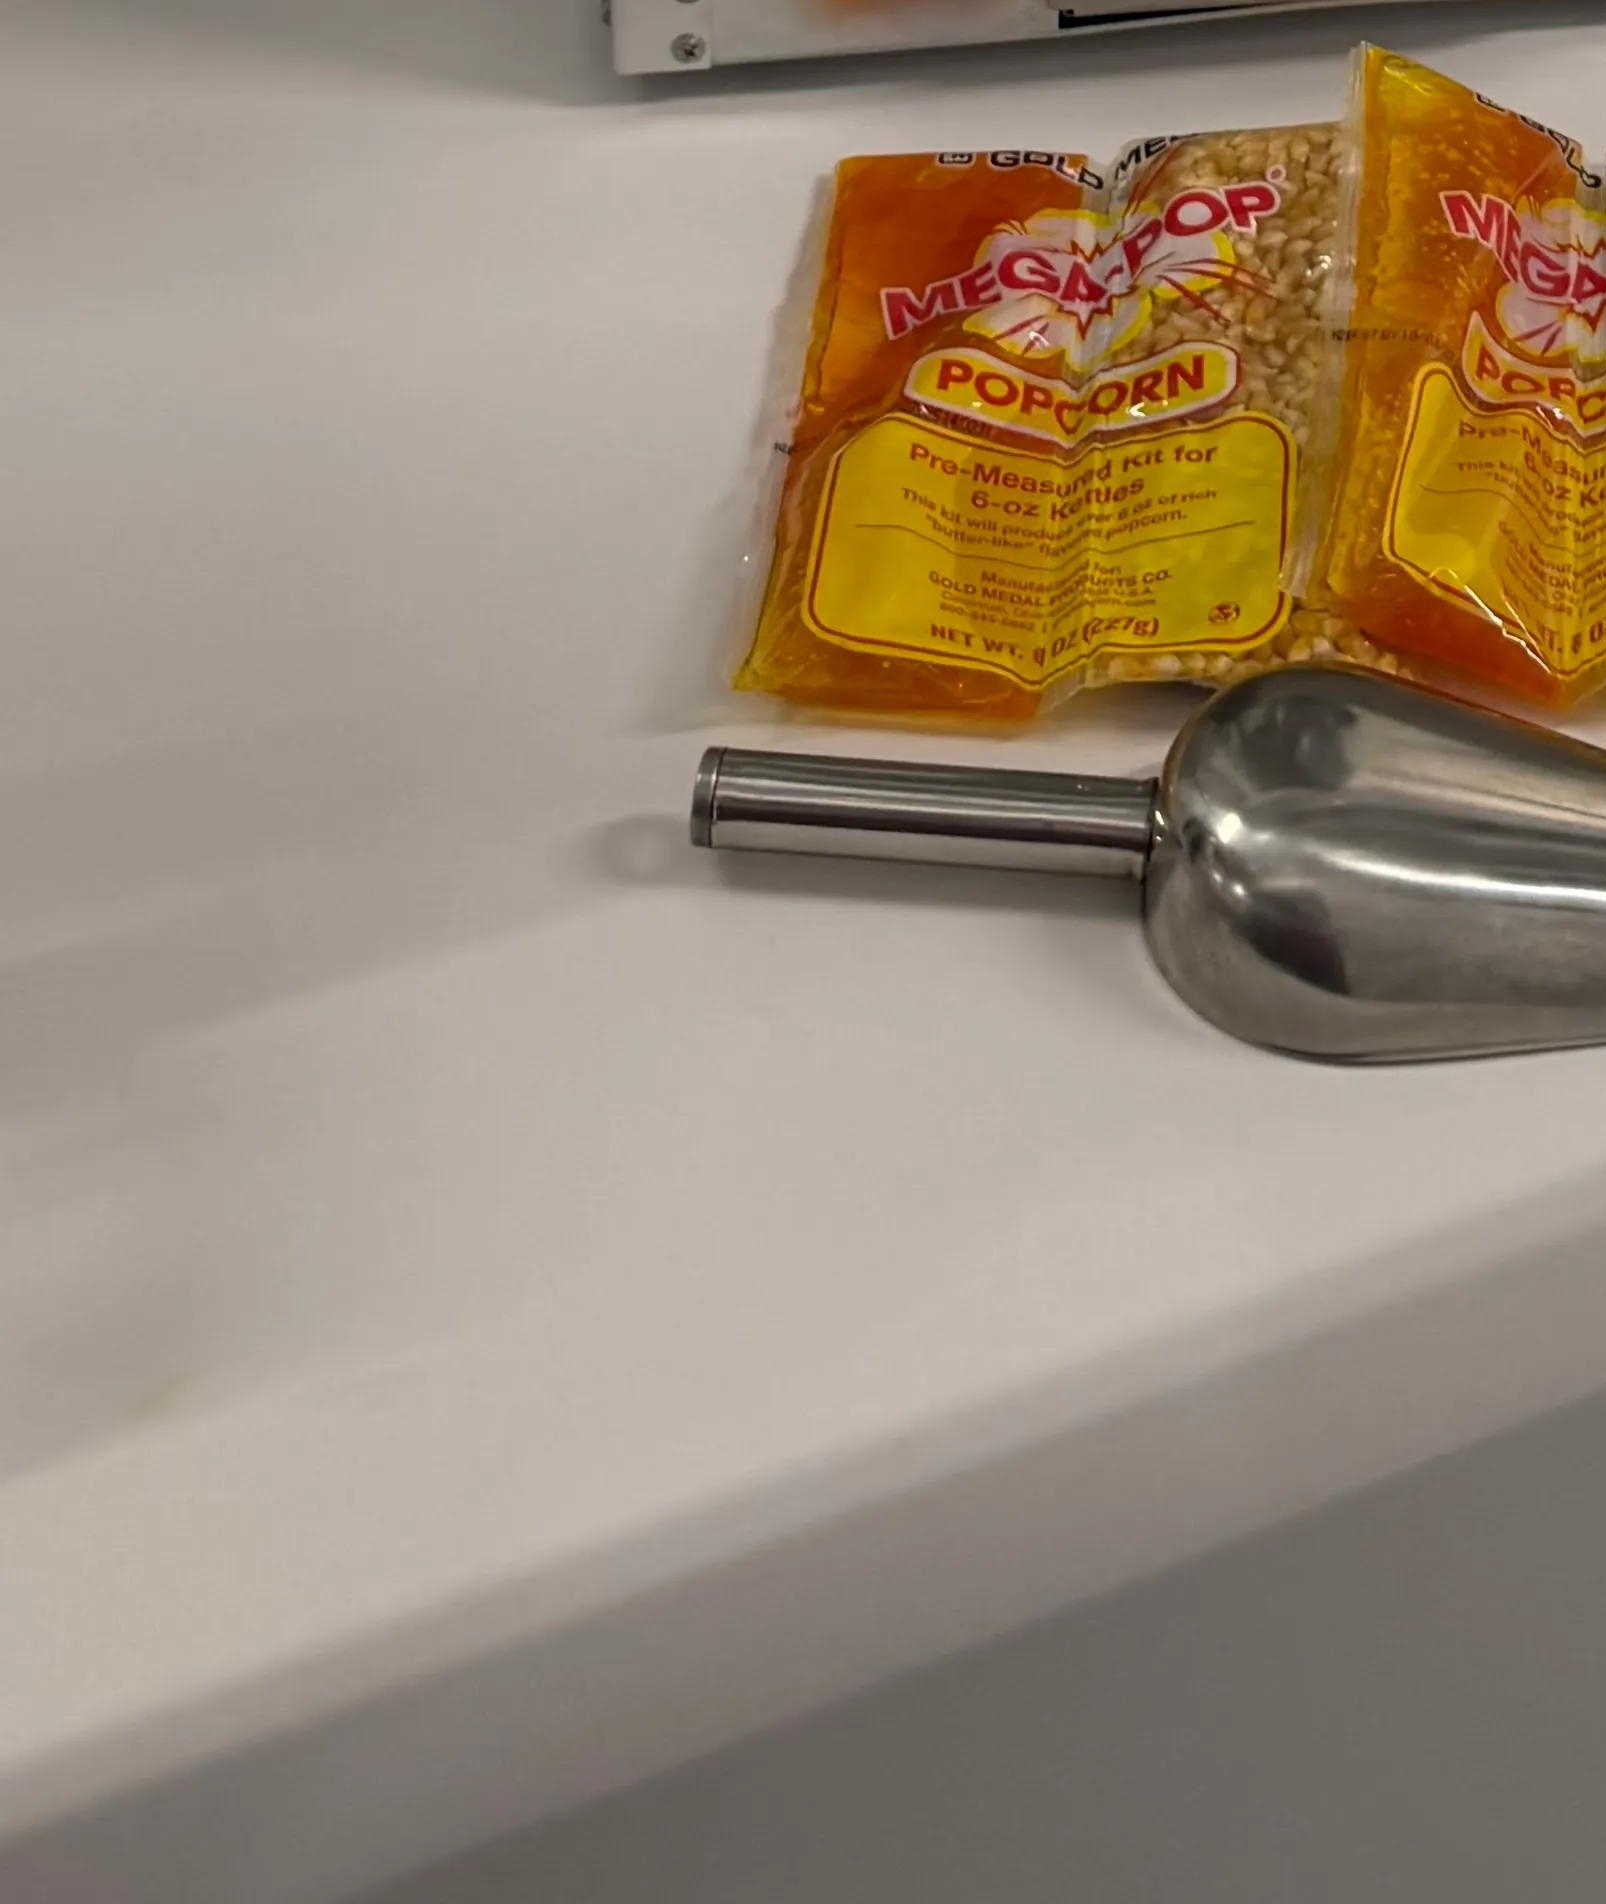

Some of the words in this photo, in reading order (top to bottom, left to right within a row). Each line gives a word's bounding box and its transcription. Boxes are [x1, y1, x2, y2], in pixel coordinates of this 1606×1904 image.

[883, 183, 1279, 339] MEGA-POP
[935, 353, 1206, 436] POPCORN
[1122, 448, 1164, 473] Kit
[1173, 443, 1219, 465] for
[902, 486, 937, 513] This
[965, 514, 997, 533] will
[1180, 489, 1218, 503] rich
[971, 489, 1040, 518] 6-oz
[928, 570, 977, 595] GOLD
[981, 585, 1044, 607] MEDAL
[931, 624, 976, 647] NET
[982, 637, 1024, 660] WT.
[1082, 616, 1160, 644] (227g)
